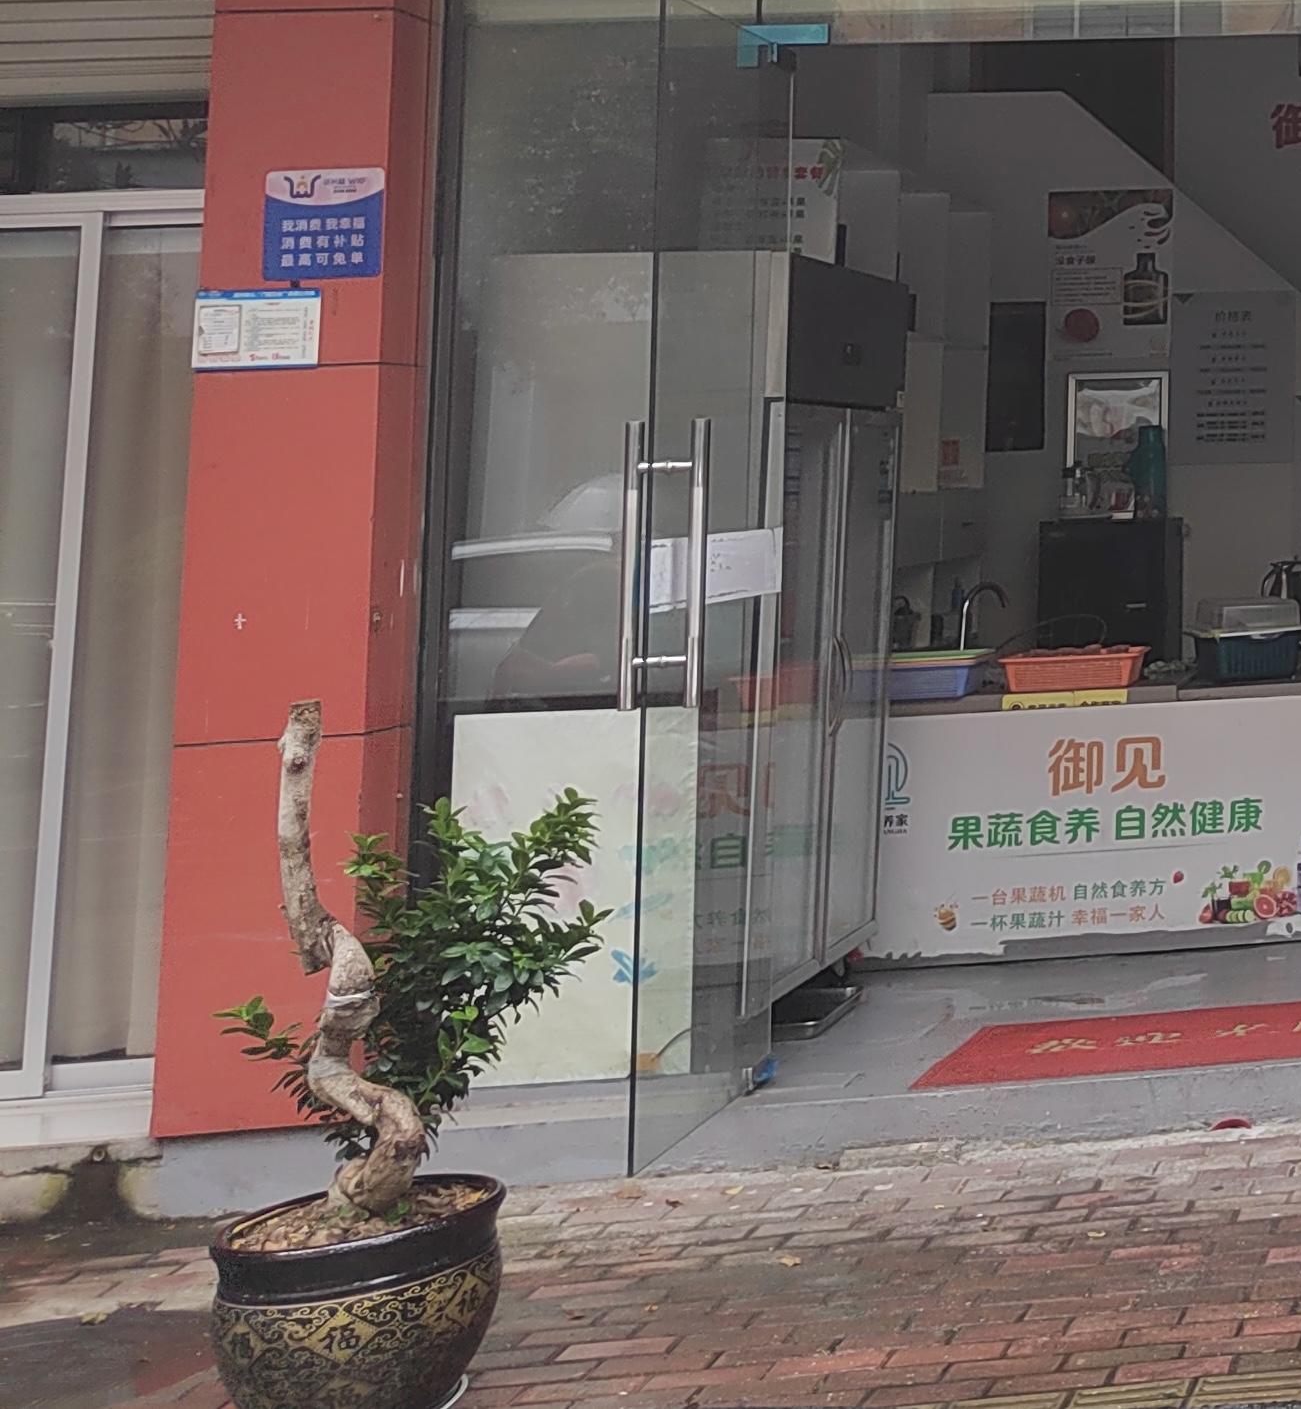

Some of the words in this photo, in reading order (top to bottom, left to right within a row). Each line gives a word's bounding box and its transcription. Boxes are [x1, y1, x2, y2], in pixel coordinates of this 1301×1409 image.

[1047, 735, 1167, 797] 御见
[947, 807, 1101, 851] 果蔬食养
[1114, 797, 1264, 841] 自然健康
[971, 885, 1066, 906] 一台果蔬机
[1073, 878, 1167, 901] 自然食养方
[970, 910, 1066, 931] 一杯果蔬汁
[1071, 903, 1166, 926] 幸福一家人
